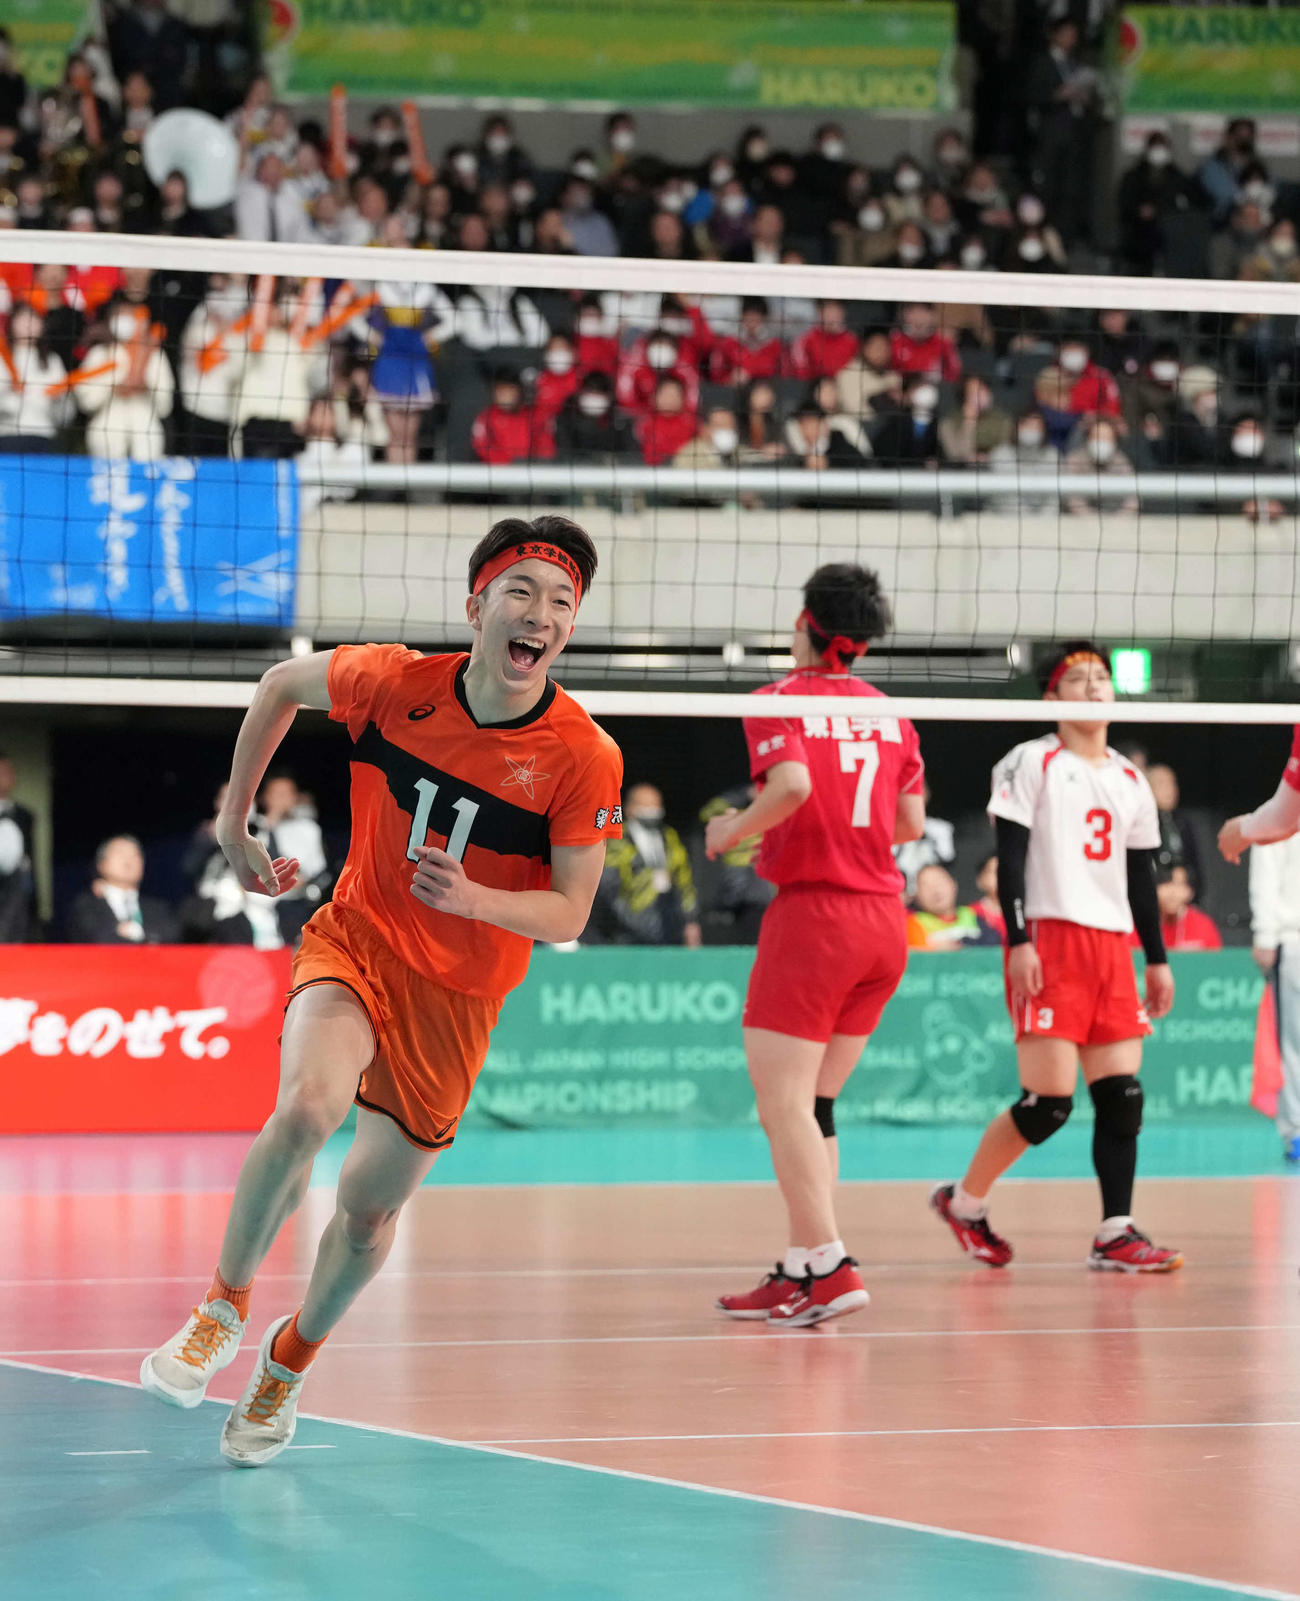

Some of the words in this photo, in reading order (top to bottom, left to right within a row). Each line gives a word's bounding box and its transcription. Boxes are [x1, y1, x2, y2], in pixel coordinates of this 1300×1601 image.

[838, 741, 880, 828] 7
[406, 777, 480, 862] 11
[1083, 808, 1112, 862] 3
[540, 980, 740, 1025] HARUKO
[1037, 1007, 1053, 1030] 3
